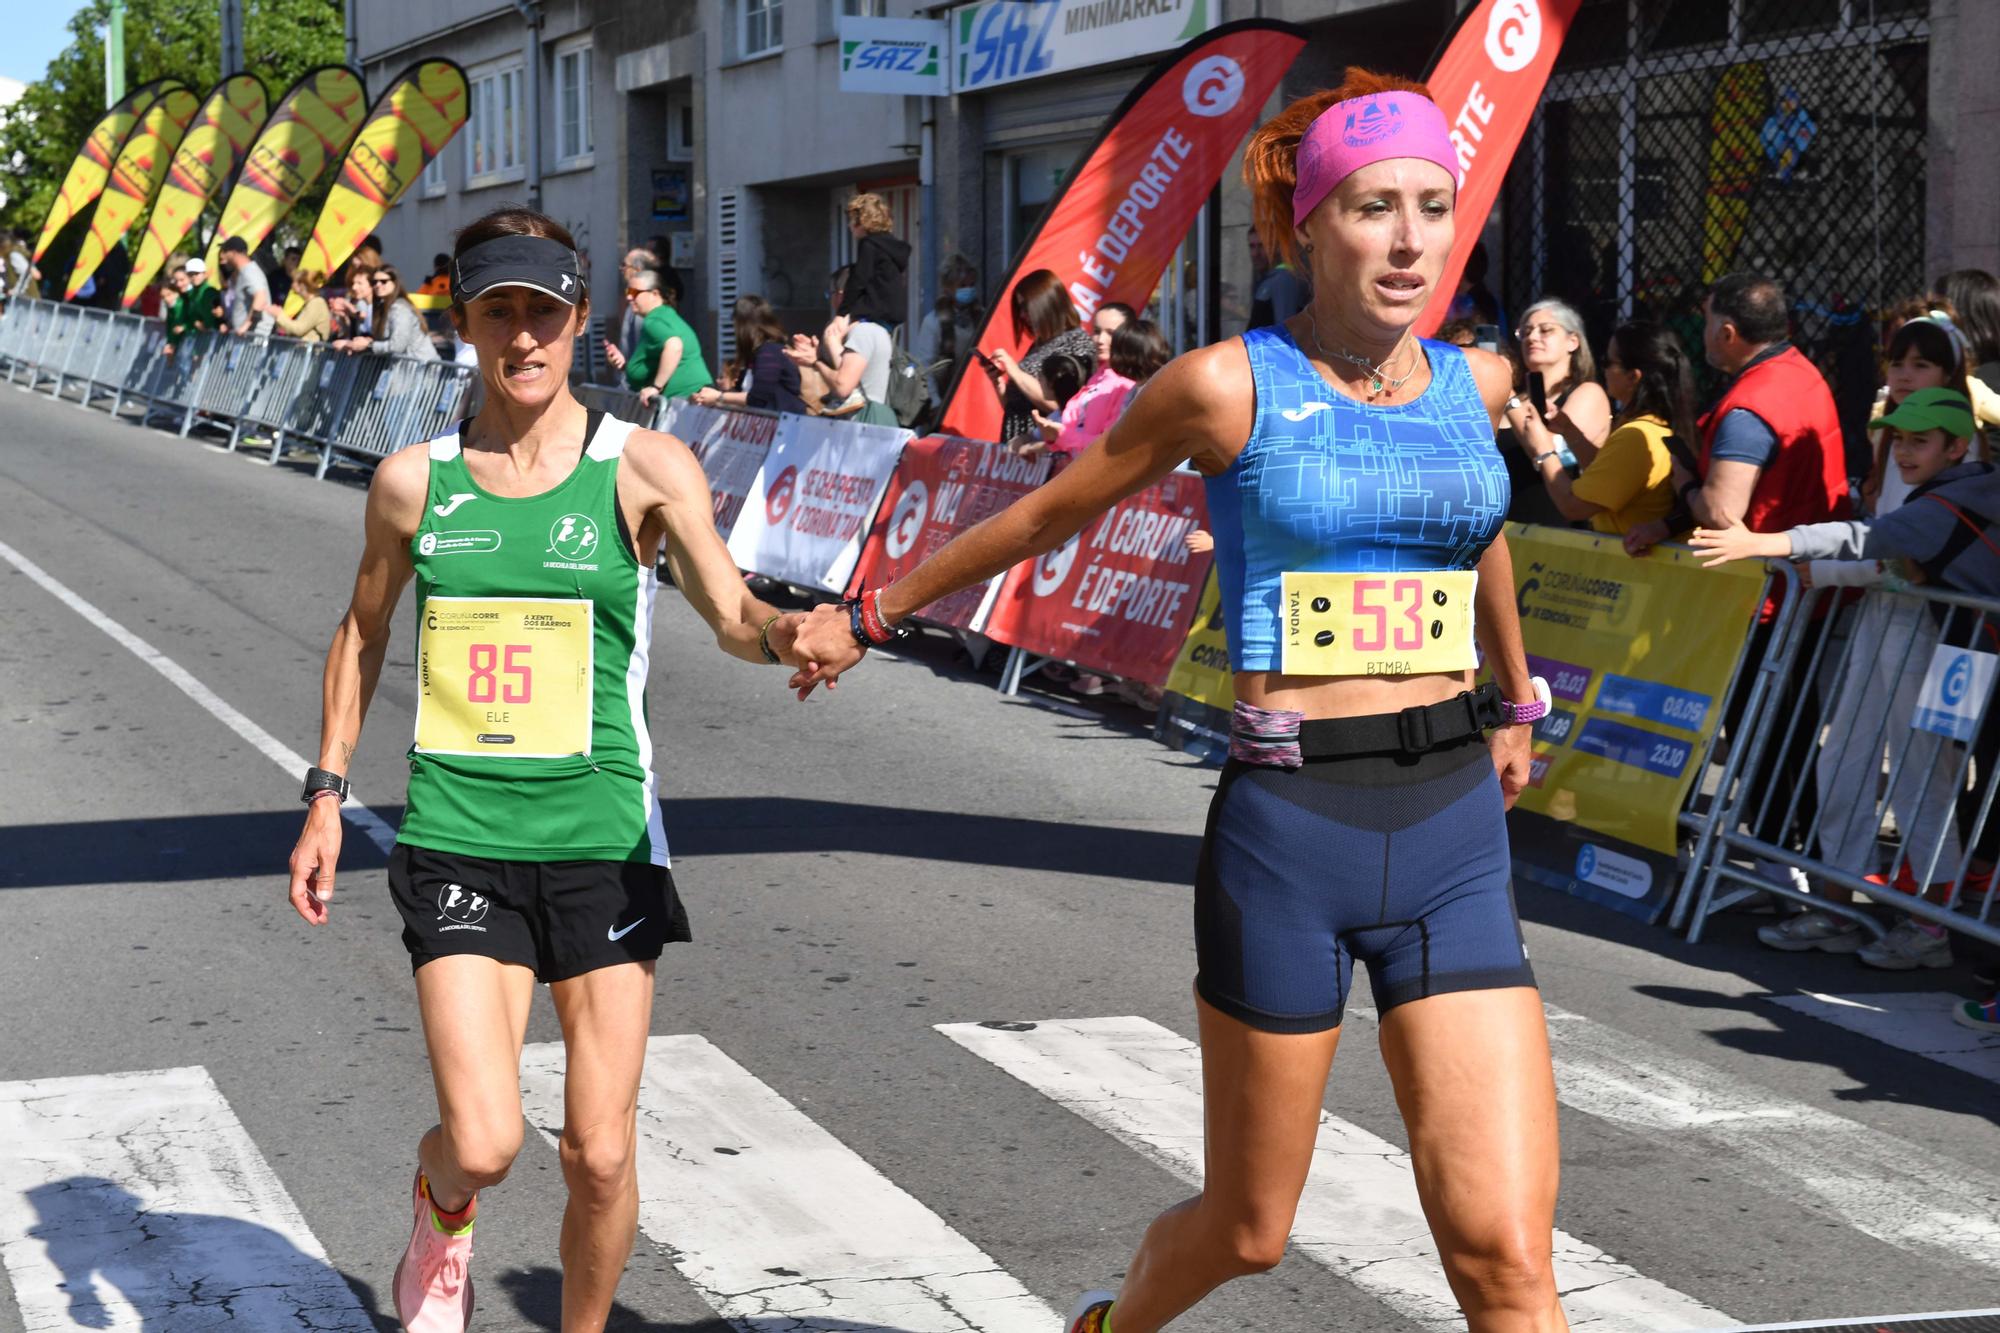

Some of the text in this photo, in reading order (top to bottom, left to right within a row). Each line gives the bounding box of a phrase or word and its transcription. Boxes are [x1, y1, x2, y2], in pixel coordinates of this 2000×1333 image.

[856, 46, 924, 71] SAZ
[970, 0, 1062, 85] SAZ
[1095, 126, 1193, 265] DEPORTE
[1079, 249, 1116, 289] É
[1090, 505, 1117, 549] A
[1109, 506, 1200, 566] CORUÑA
[1071, 554, 1190, 630] É DEPORTE
[1289, 590, 1300, 636] TANDA
[1353, 579, 1424, 652] 53
[422, 651, 431, 688] TANDA
[467, 643, 533, 704] 85
[1366, 660, 1412, 676] BIMBA
[485, 711, 510, 723] ELE
[1650, 743, 1686, 769] 23.10
